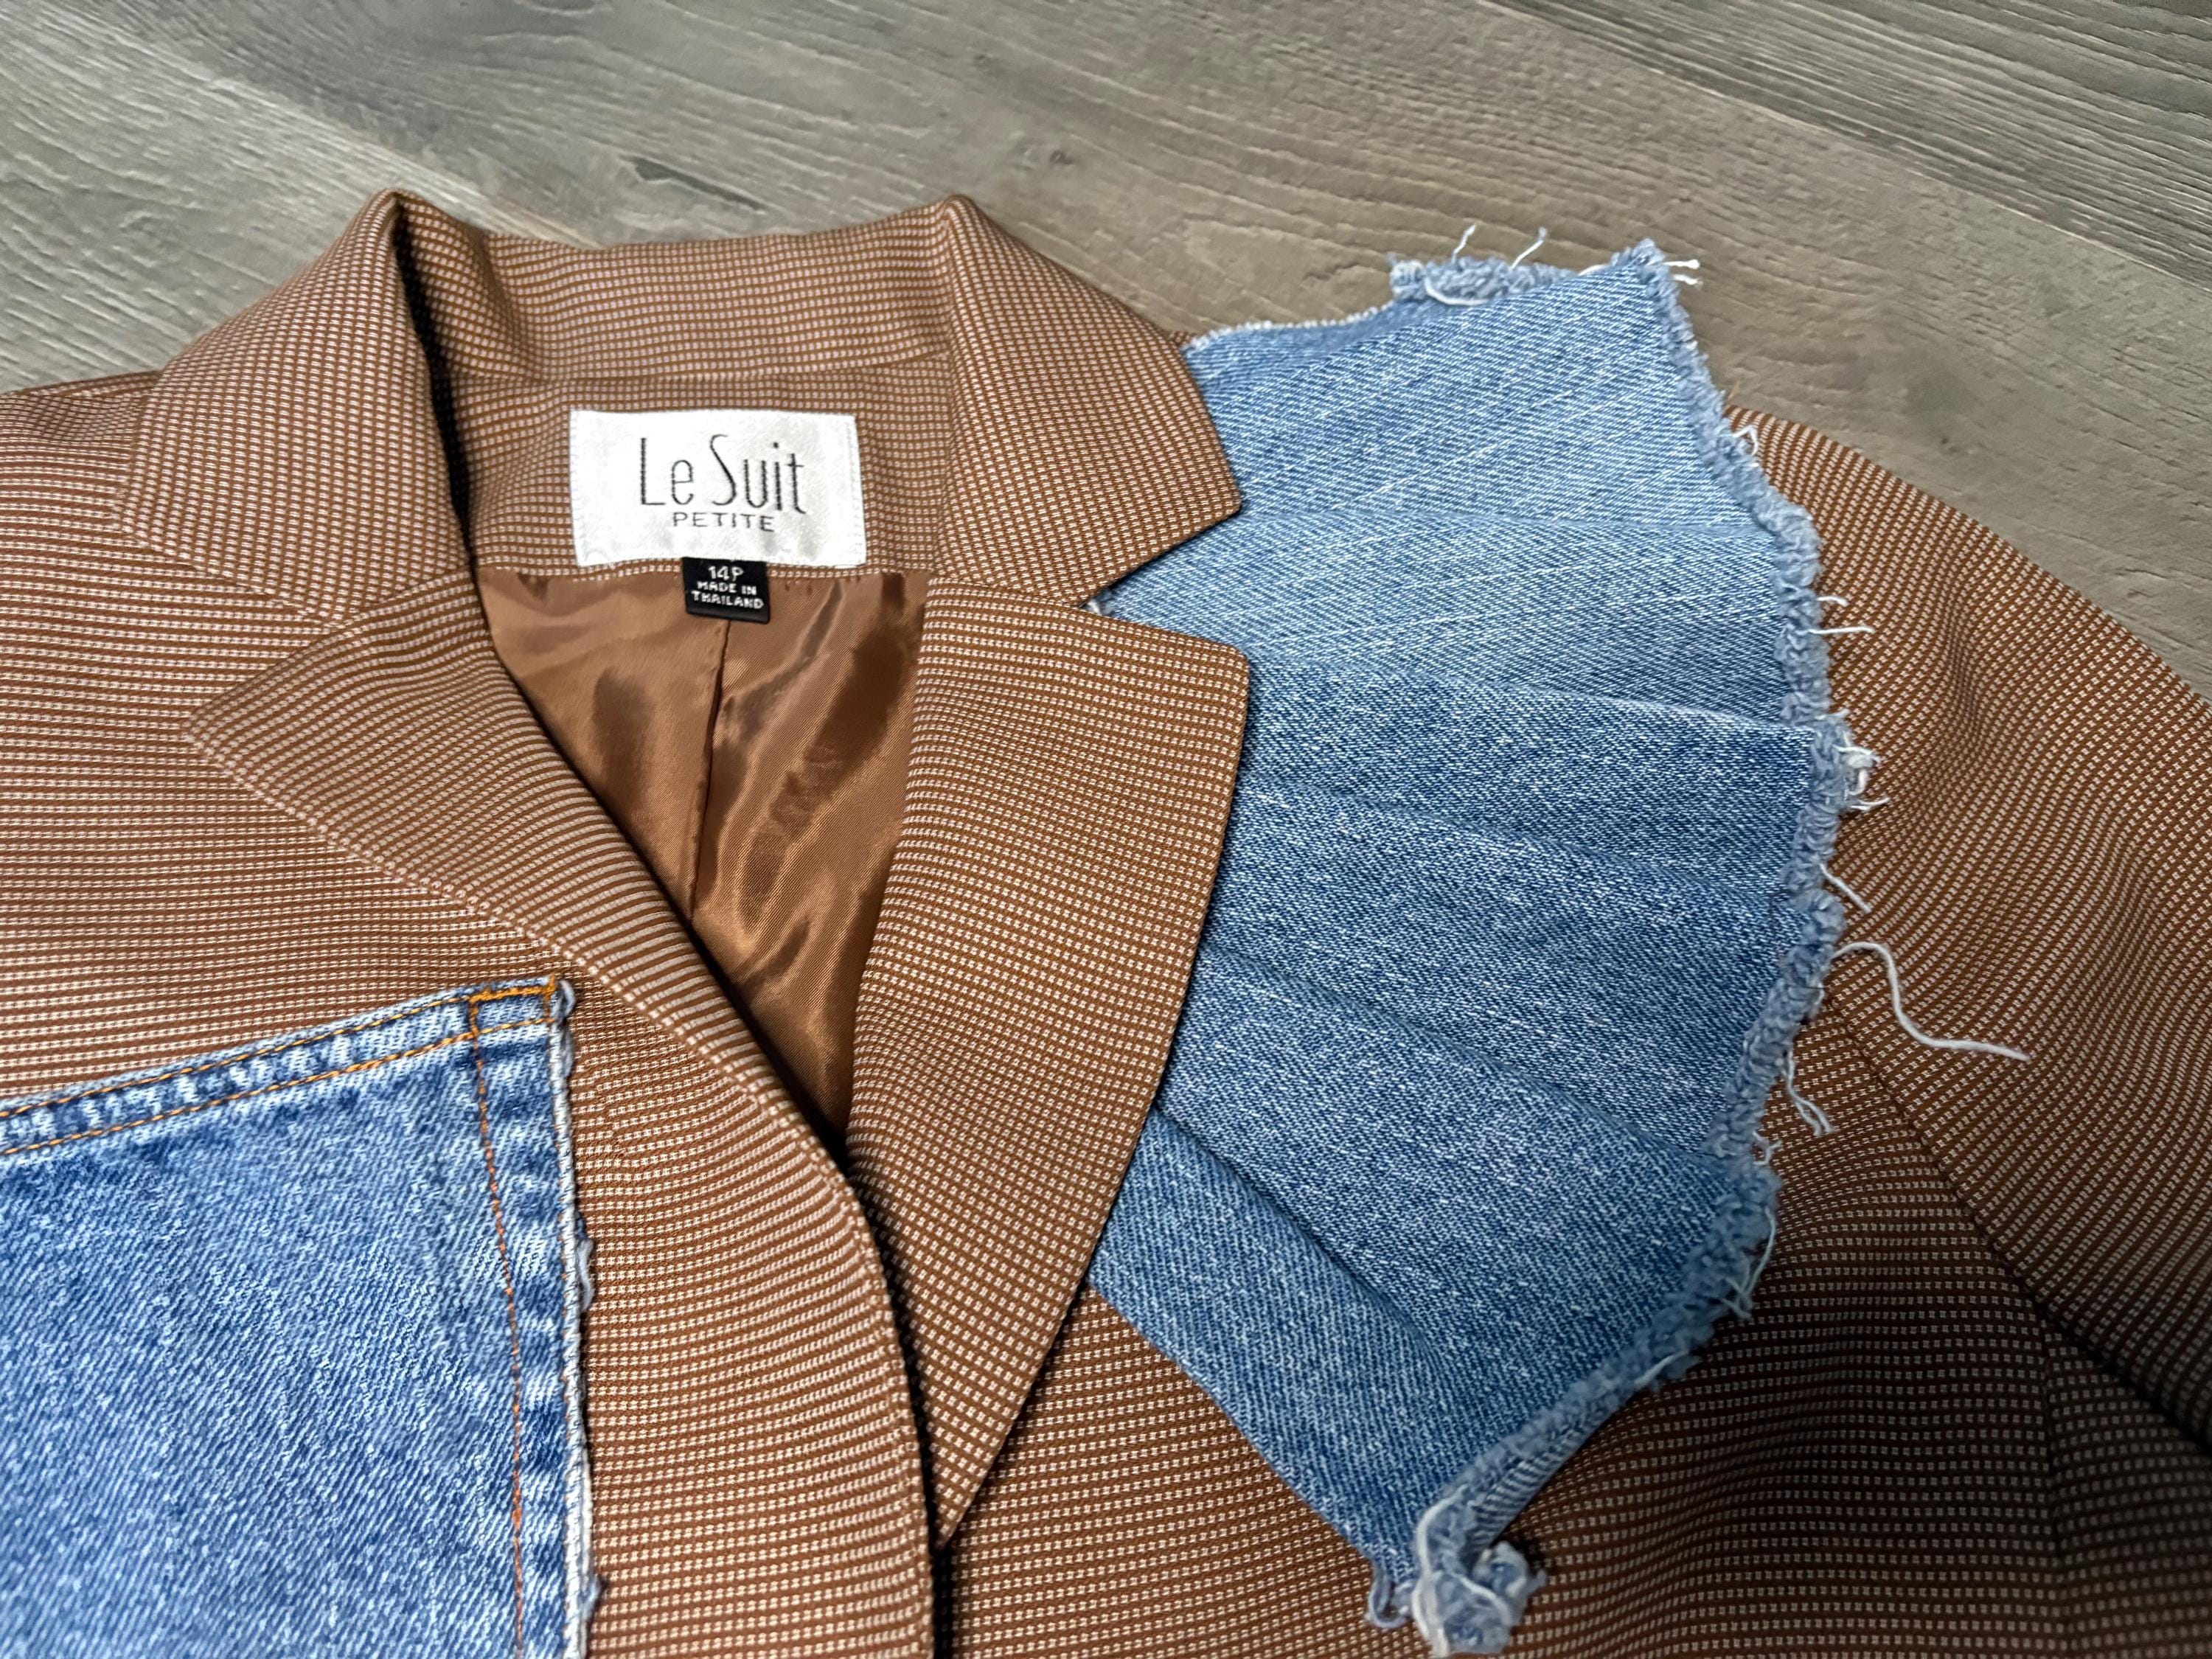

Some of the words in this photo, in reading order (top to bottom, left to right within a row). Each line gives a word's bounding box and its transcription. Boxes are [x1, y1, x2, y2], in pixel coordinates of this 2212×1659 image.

[640, 437, 695, 506] Le
[709, 434, 807, 515] Suit
[672, 511, 775, 532] PETITE
[708, 566, 744, 582] 14P
[697, 580, 737, 594] MADE
[741, 585, 757, 596] IN
[691, 590, 765, 610] THAILAND
